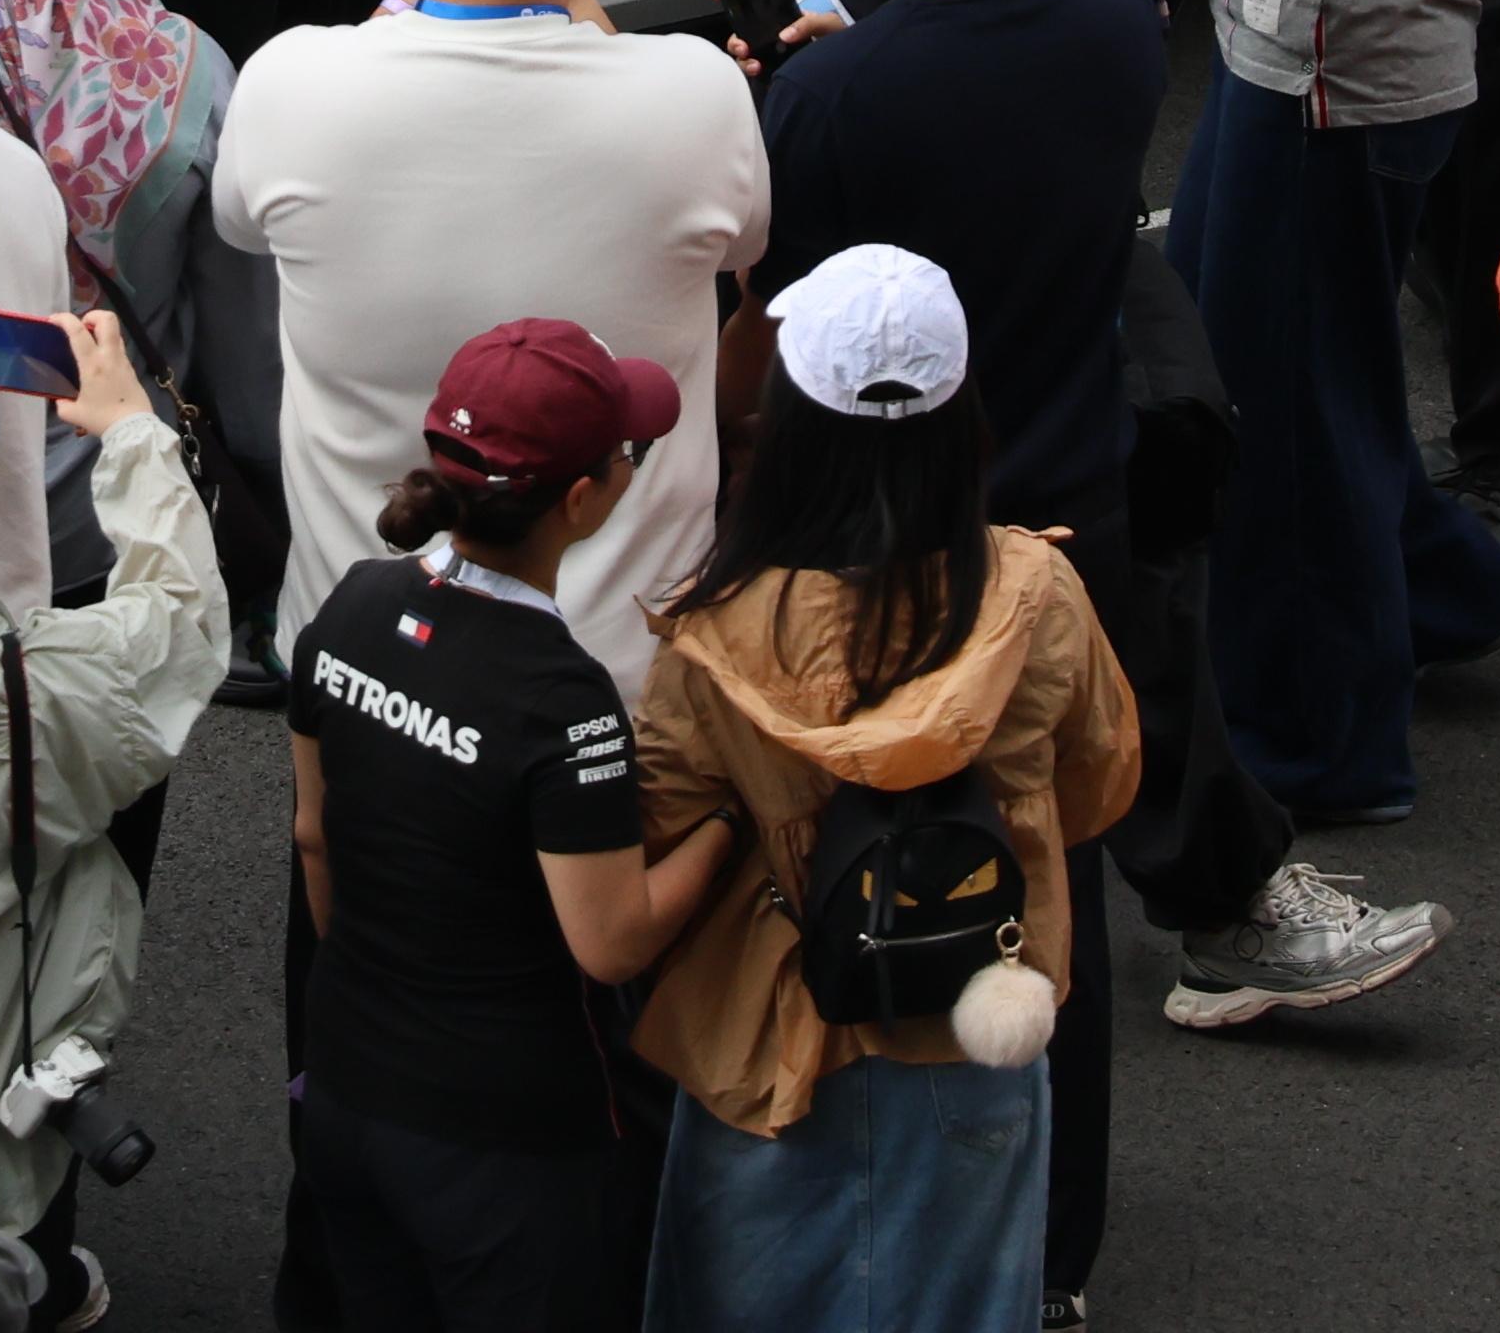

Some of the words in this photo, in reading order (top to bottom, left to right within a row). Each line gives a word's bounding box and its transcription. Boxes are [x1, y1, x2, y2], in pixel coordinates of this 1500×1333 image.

[314, 650, 481, 766] PETRONAS
[567, 713, 620, 743] EPSON
[570, 736, 627, 761] BOSE
